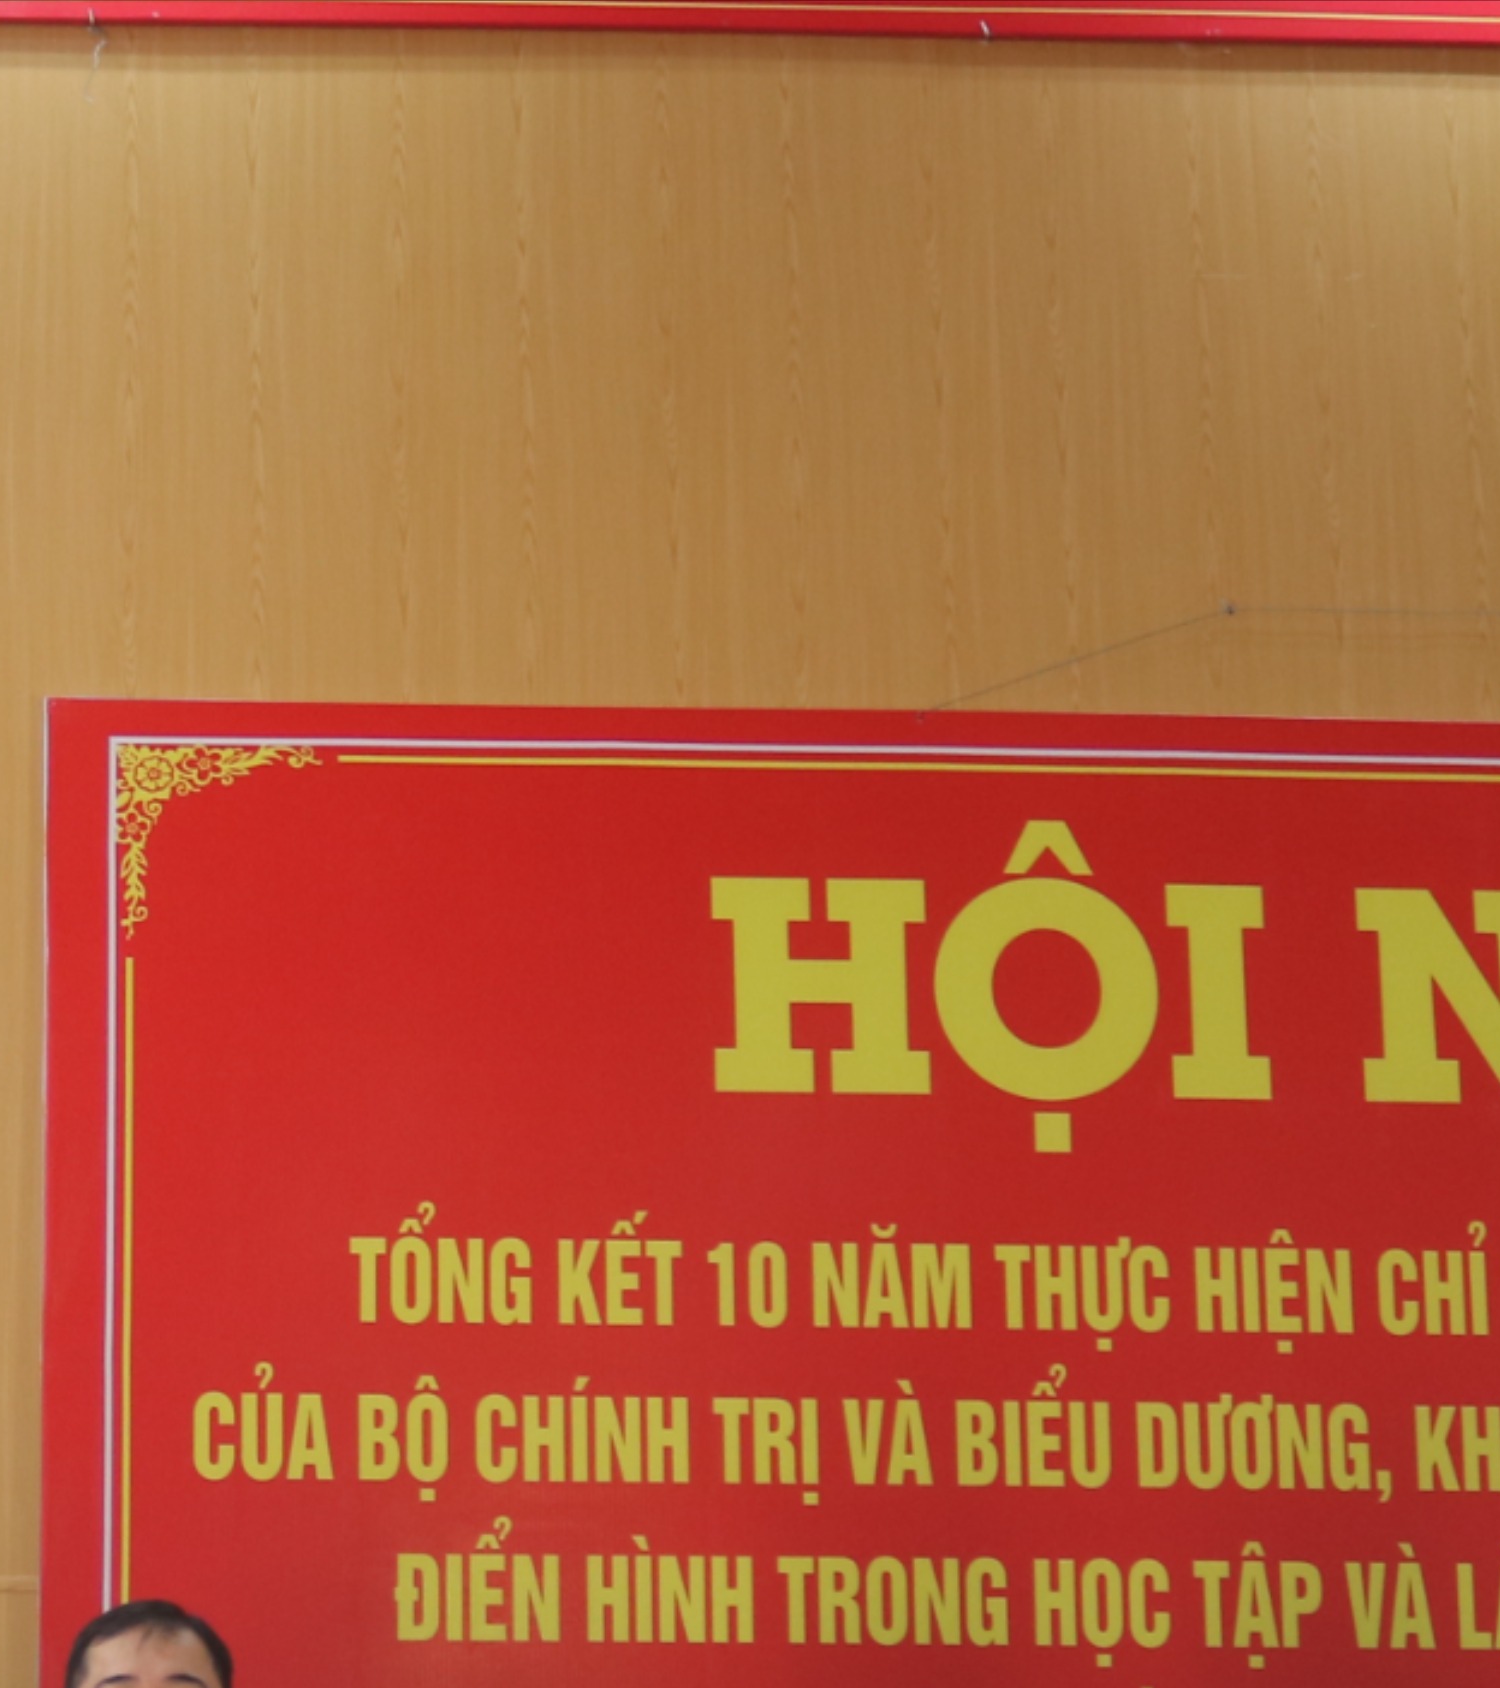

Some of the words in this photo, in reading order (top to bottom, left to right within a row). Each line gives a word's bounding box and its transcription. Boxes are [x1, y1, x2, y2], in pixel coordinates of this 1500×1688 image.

[710, 820, 1272, 1152] HỘI
[349, 1201, 532, 1325] TỔNG
[558, 1210, 683, 1325] KẾT
[707, 1241, 788, 1328] 10
[812, 1224, 972, 1328] NĂM
[994, 1237, 1170, 1351] THỰC
[1195, 1229, 1354, 1353] HIỆN
[1378, 1221, 1489, 1335] CHỈ
[193, 1361, 334, 1481] CỦA
[358, 1375, 449, 1502] BỘ
[475, 1376, 690, 1483] CHÍNH
[712, 1397, 819, 1505] TRỊ
[843, 1380, 933, 1485] VÀ
[956, 1364, 1111, 1488] BIỂU
[1136, 1394, 1391, 1501] DƯƠNG,
[394, 1515, 560, 1642] ĐIỂN
[586, 1535, 754, 1643] HÌNH
[777, 1556, 1008, 1646] TRONG
[1034, 1558, 1170, 1667] HỌC
[1193, 1542, 1322, 1668] TẬP
[1346, 1543, 1435, 1649] VÀ
